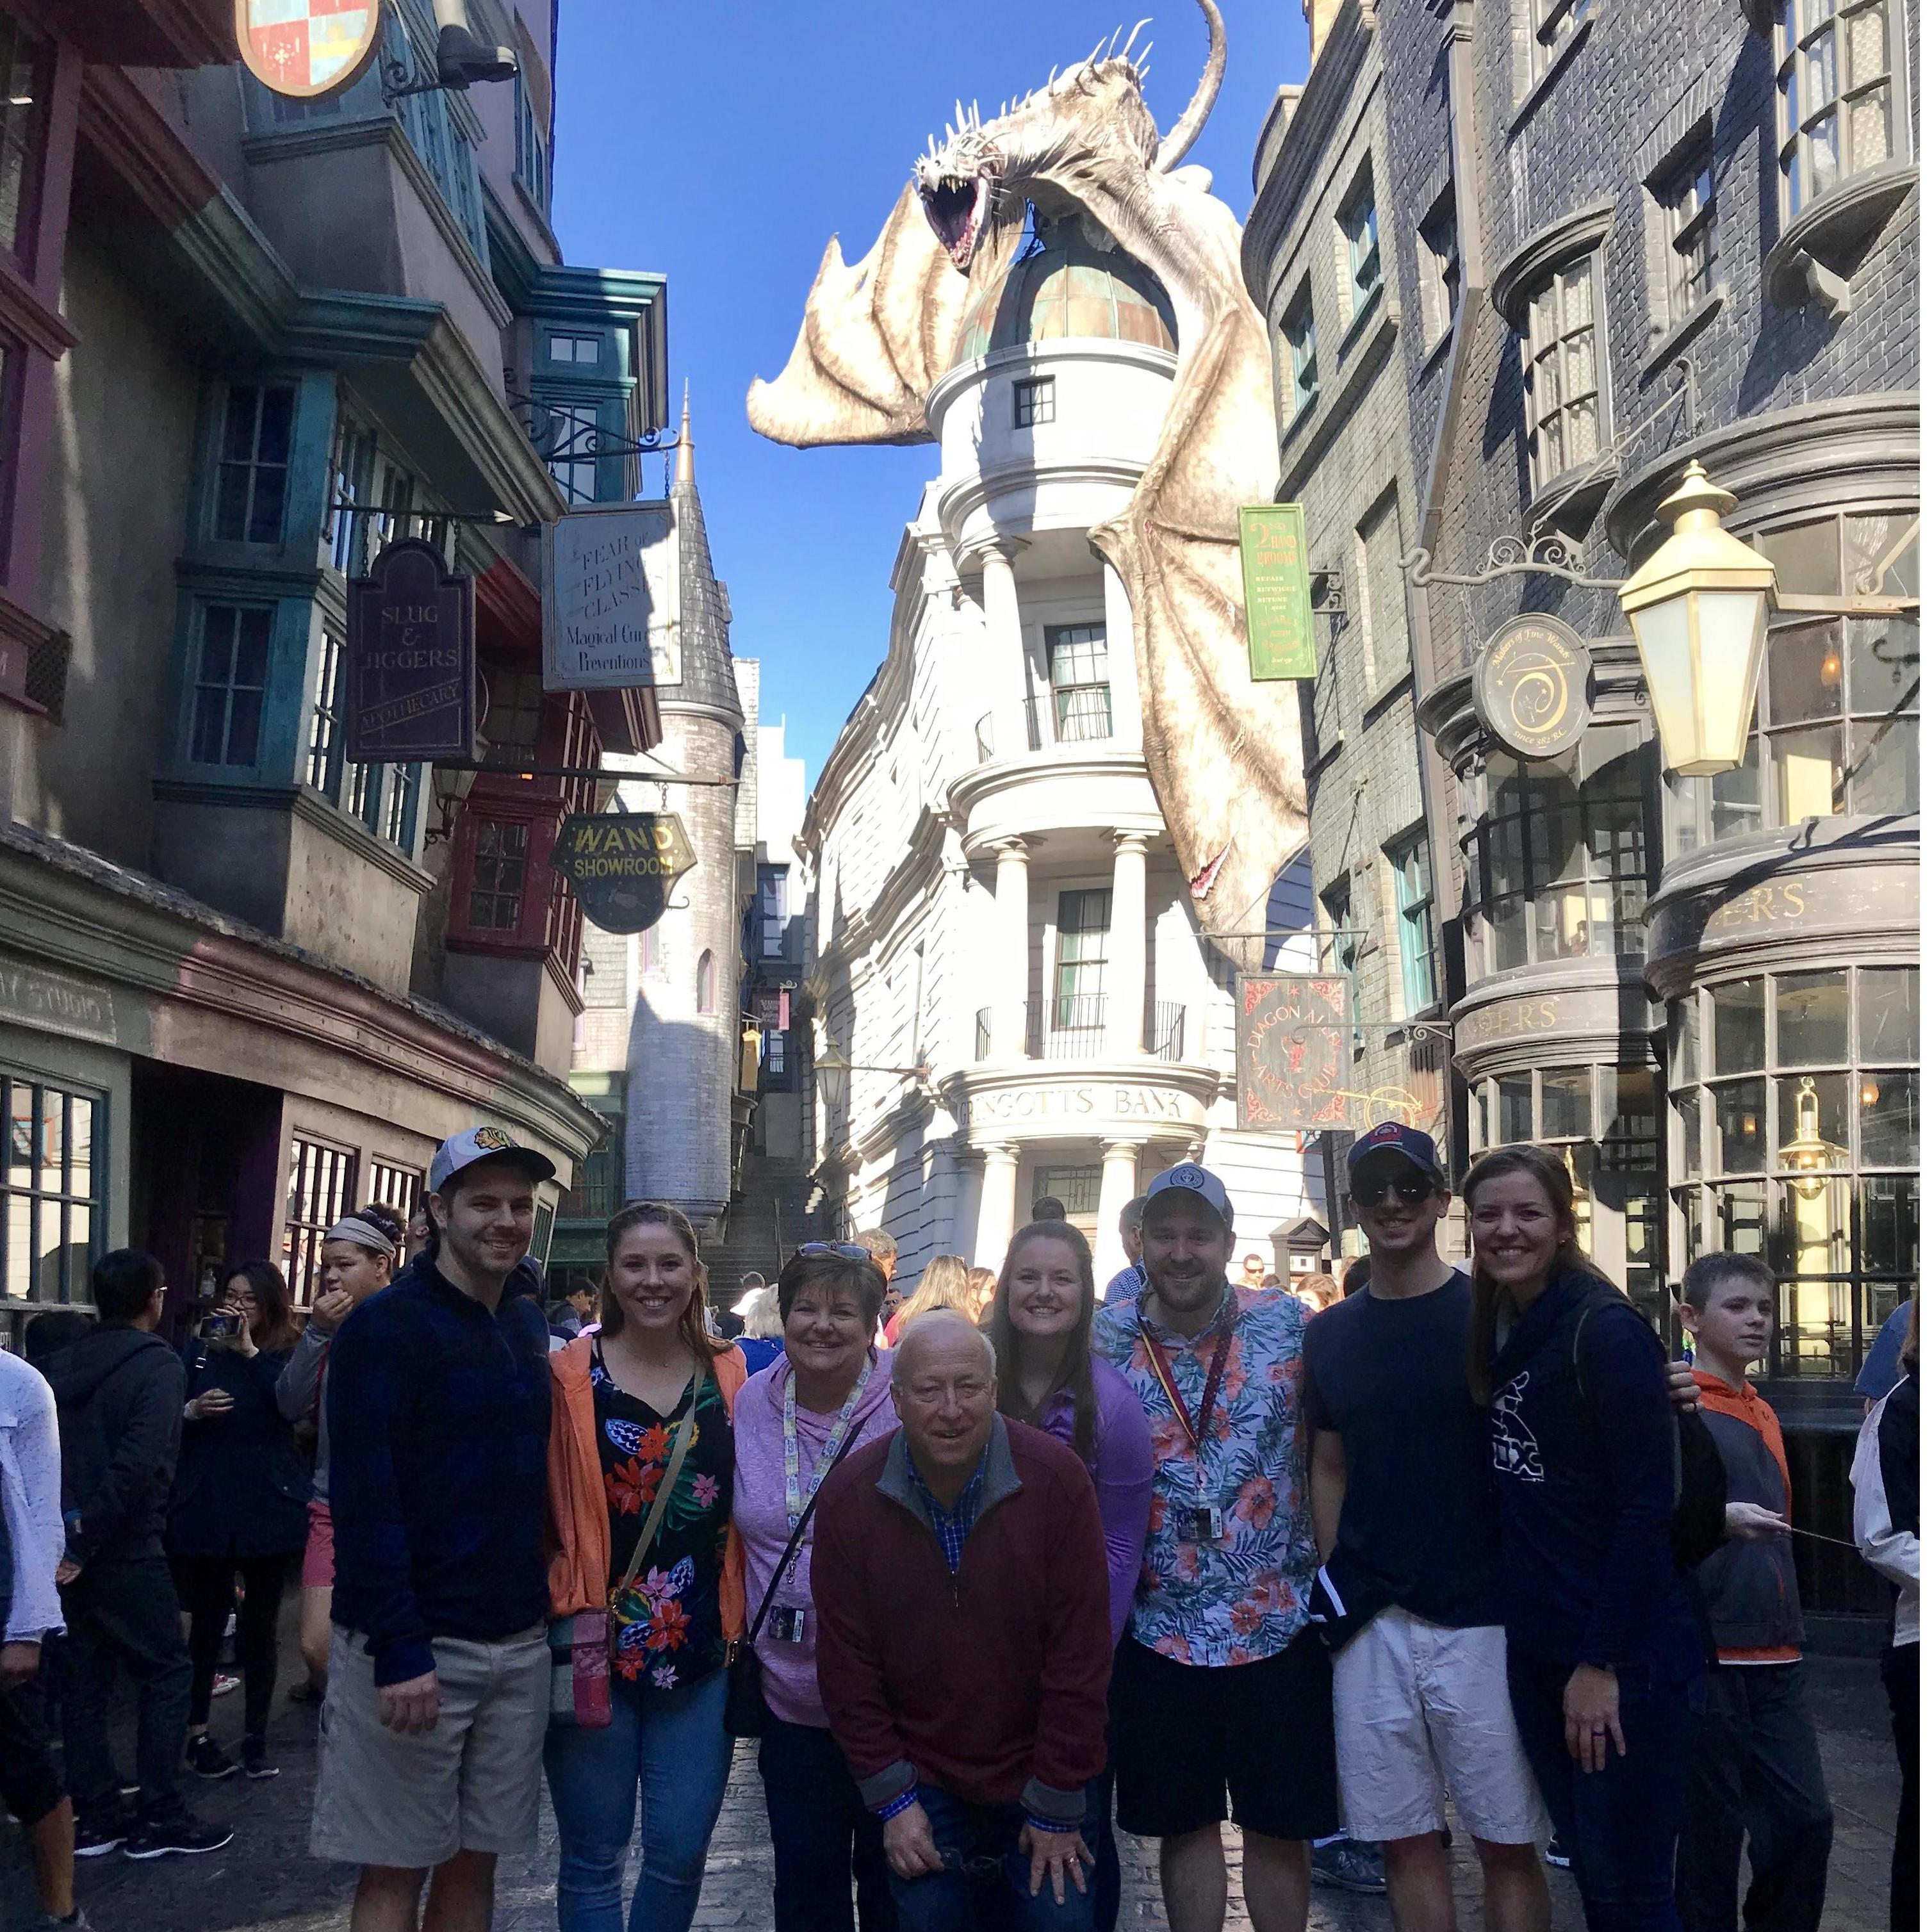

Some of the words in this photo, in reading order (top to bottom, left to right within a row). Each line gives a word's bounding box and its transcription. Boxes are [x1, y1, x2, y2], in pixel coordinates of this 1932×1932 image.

[583, 536, 628, 570] FEAR
[382, 605, 438, 624] SLUG
[402, 628, 421, 646] &
[567, 624, 617, 648] Magical
[357, 650, 457, 669] JIGGERS
[578, 651, 650, 671] Preventions
[1512, 730, 1535, 744] since
[575, 826, 673, 853] WAND
[575, 856, 673, 878] SHOWROOM
[1247, 1005, 1300, 1049] DIAGON
[1252, 1064, 1294, 1099] ARTS
[961, 1088, 1094, 1126] GRINGOTTS
[1115, 1088, 1182, 1118] BANK
